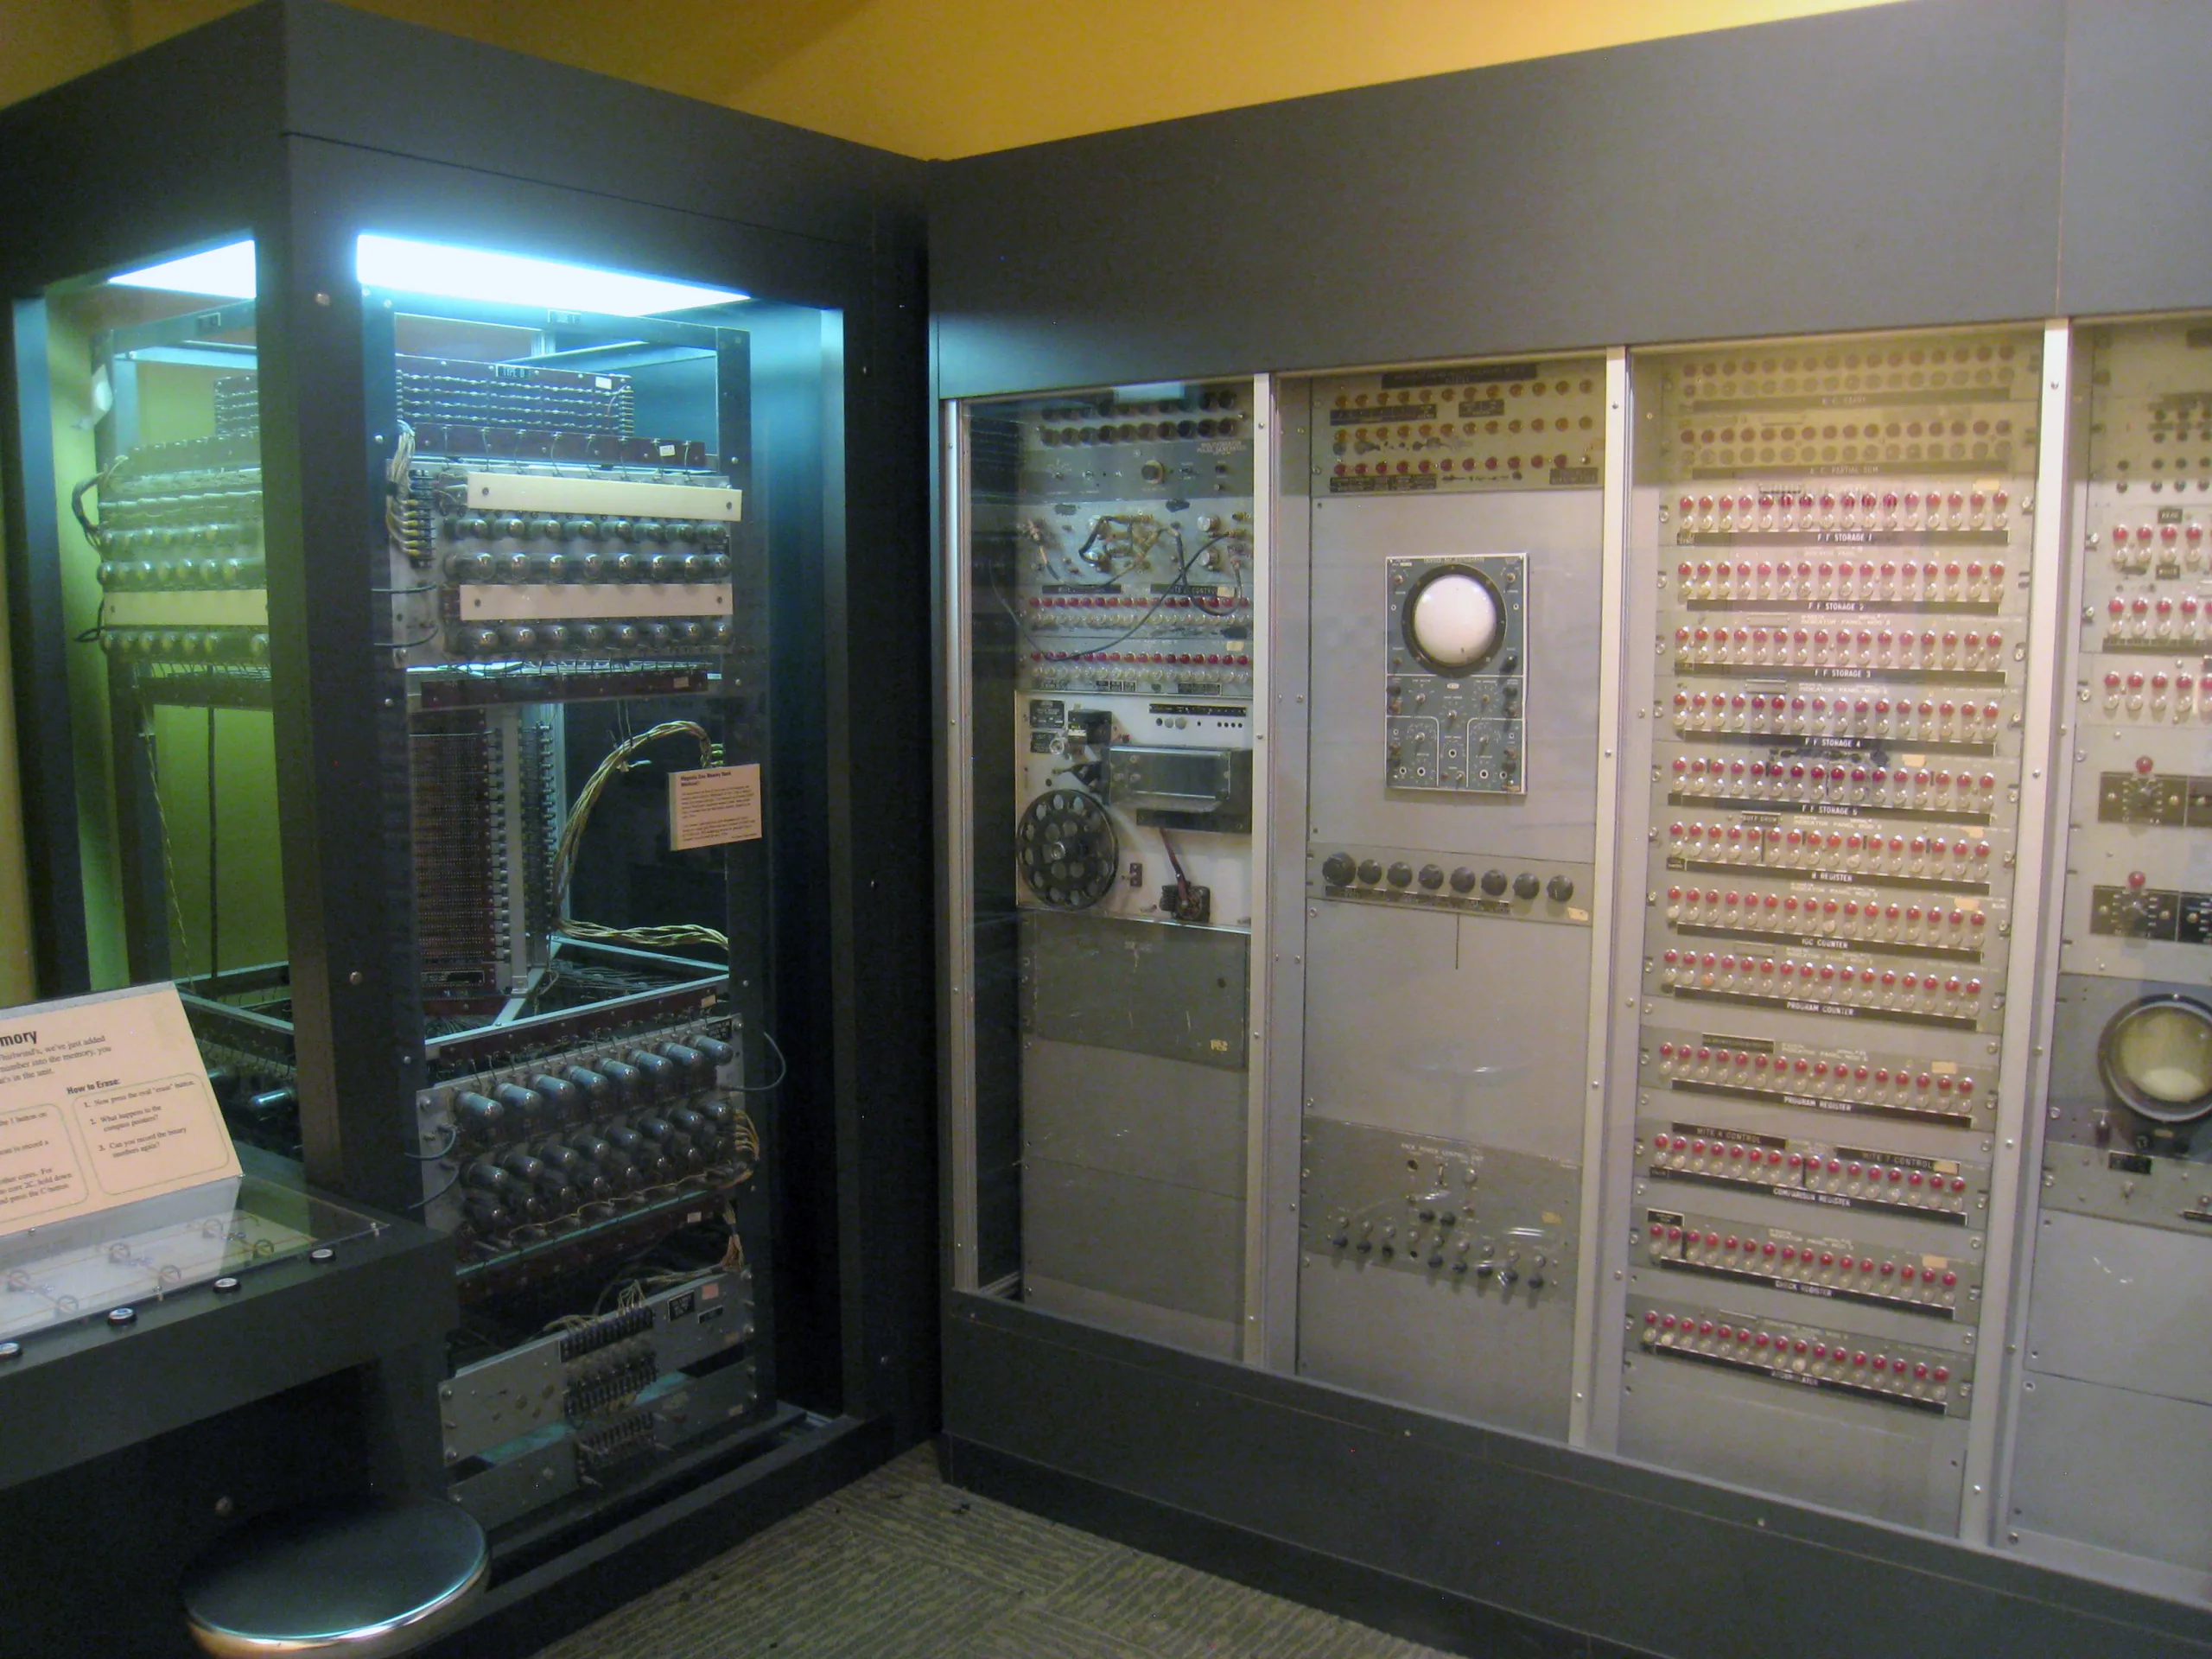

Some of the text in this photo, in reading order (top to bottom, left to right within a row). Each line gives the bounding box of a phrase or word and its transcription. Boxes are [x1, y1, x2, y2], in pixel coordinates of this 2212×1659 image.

[1832, 466, 1859, 475] PARTIAL
[1834, 533, 1865, 542] STORAGE
[1825, 603, 1856, 612] STORAGE
[1832, 669, 1862, 677] STORAGE
[1821, 739, 1853, 747] STORAGE
[1819, 805, 1849, 816] STORAGE
[1820, 873, 1853, 882] REGISTER
[1816, 939, 1848, 949] COUNTER
[1786, 1001, 1855, 1016] PROGRAM COUNTER
[67, 1040, 82, 1050] just
[83, 1035, 105, 1046] added
[97, 1046, 111, 1055] you
[22, 1071, 35, 1080] the
[67, 1085, 86, 1096] How
[1783, 1095, 1852, 1111] PROGRAM REGISTER
[1696, 1127, 1714, 1136] MITE
[1727, 1132, 1762, 1144] CONTROL
[124, 1139, 136, 1147] you
[1893, 1157, 1933, 1170] CONTROL
[1773, 1188, 1851, 1207] COMPARISON REGISTER
[1775, 1280, 1833, 1296] CHECK REGISTER
